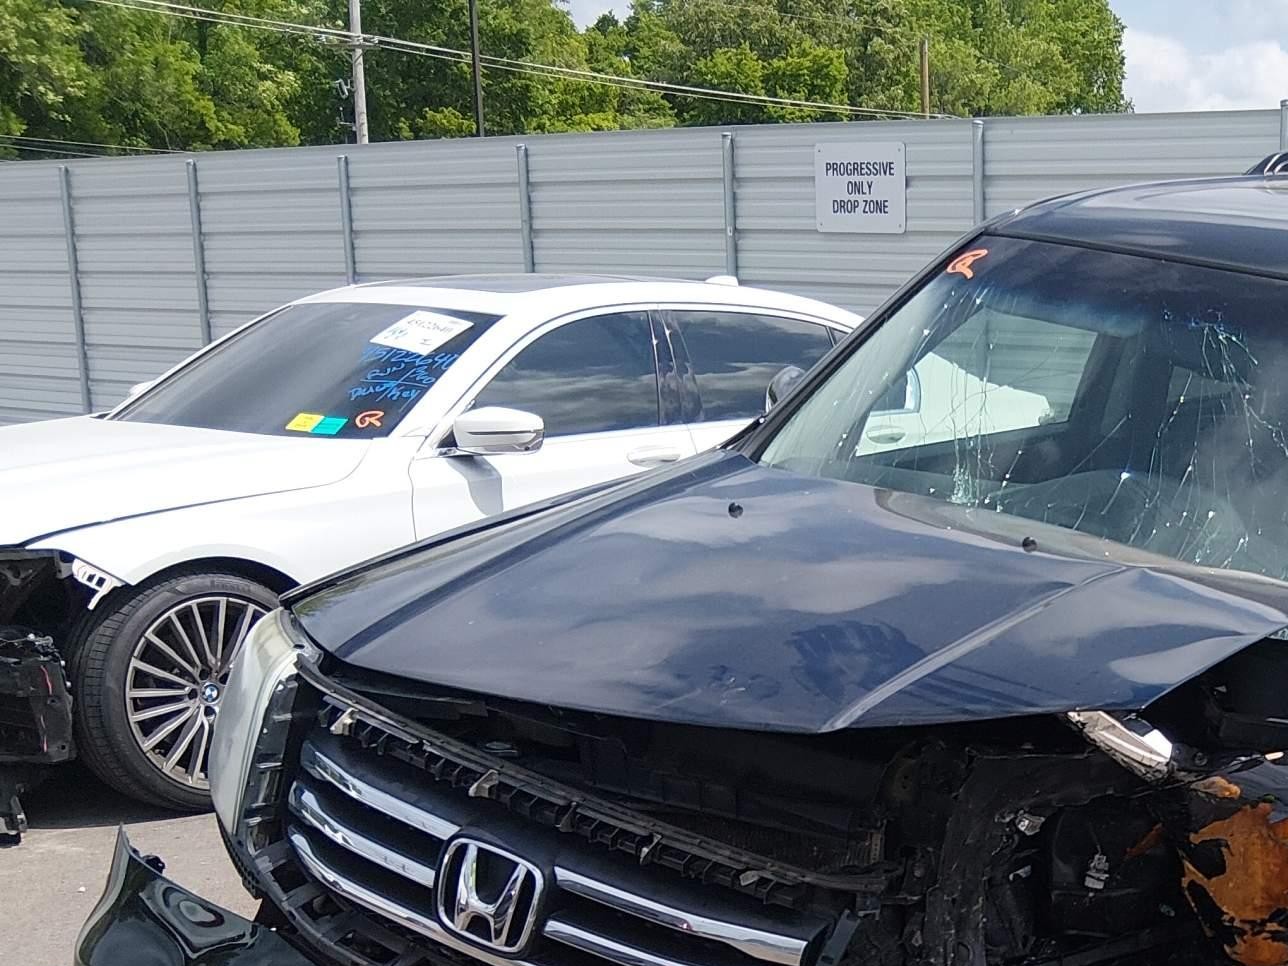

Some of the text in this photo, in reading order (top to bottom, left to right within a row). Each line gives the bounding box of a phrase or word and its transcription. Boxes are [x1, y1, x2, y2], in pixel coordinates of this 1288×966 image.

[825, 161, 895, 177] PROGRESSIVE
[846, 180, 873, 196] ONLY
[832, 199, 889, 214] DROP ZONE
